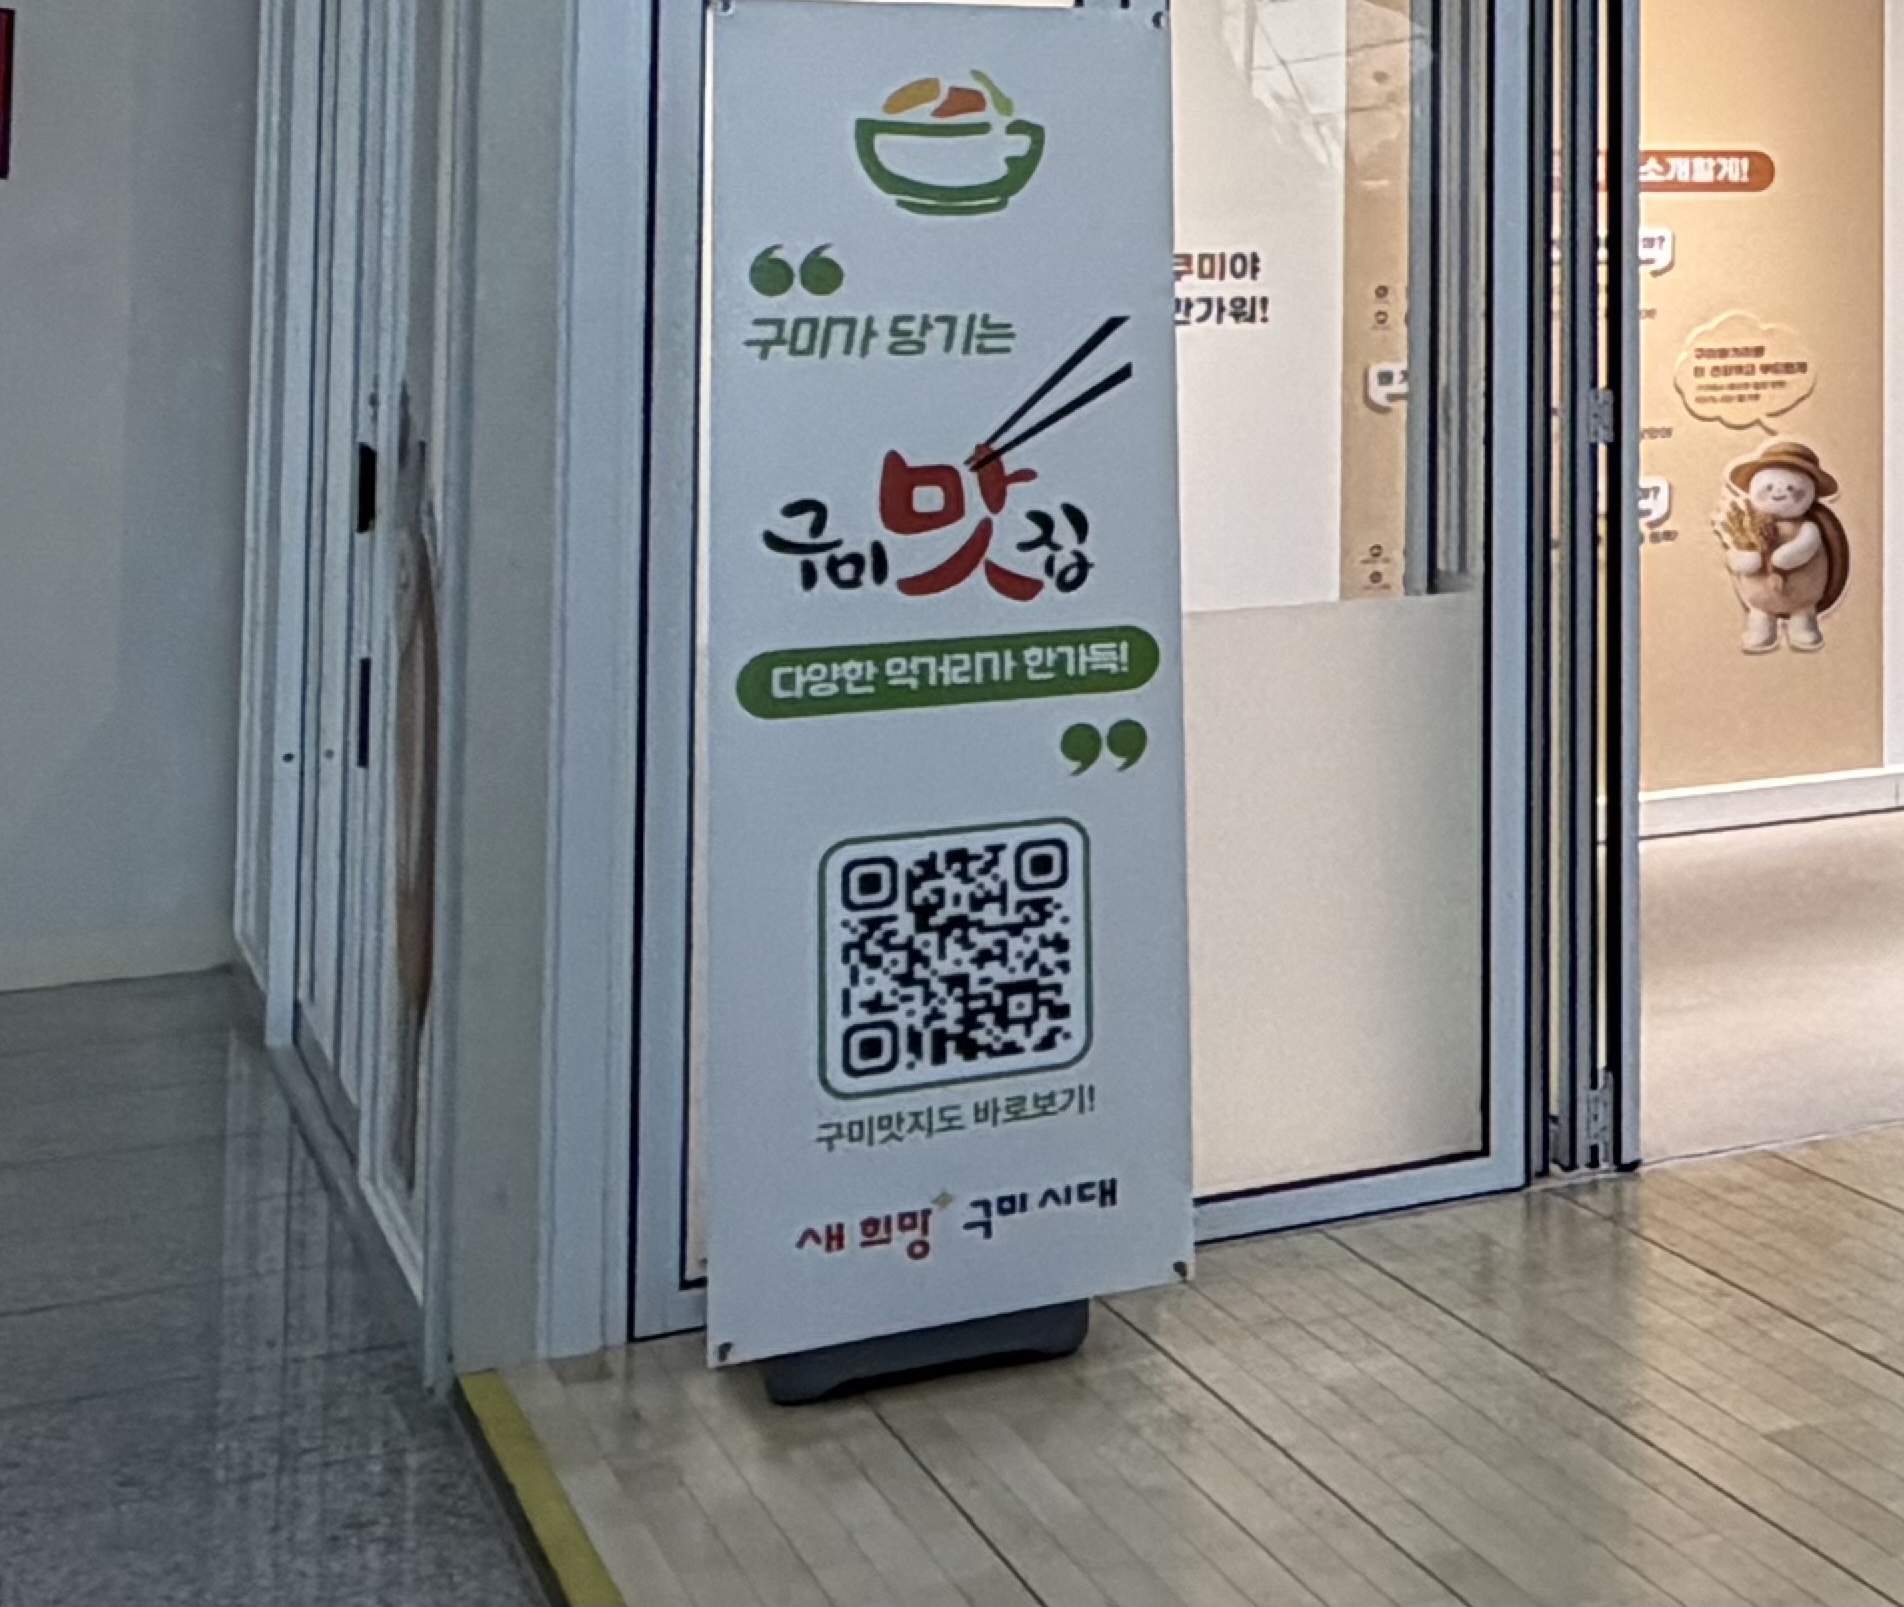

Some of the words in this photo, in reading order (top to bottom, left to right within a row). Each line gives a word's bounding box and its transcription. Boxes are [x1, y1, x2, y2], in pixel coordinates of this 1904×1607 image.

[744, 314, 877, 360] 구미가
[886, 311, 1016, 357] 당기는
[762, 444, 1094, 601] 구미맛집
[770, 650, 878, 699] 다양한
[884, 644, 1018, 692] 먹거리가
[1023, 639, 1130, 681] 한가득!
[815, 1104, 966, 1153] 구미맛지도
[972, 1083, 1097, 1129] 바로보기!
[795, 1220, 845, 1254] 새
[858, 1206, 933, 1260] 희망
[960, 1189, 1031, 1240] 구미
[1037, 1177, 1118, 1211] 시대
